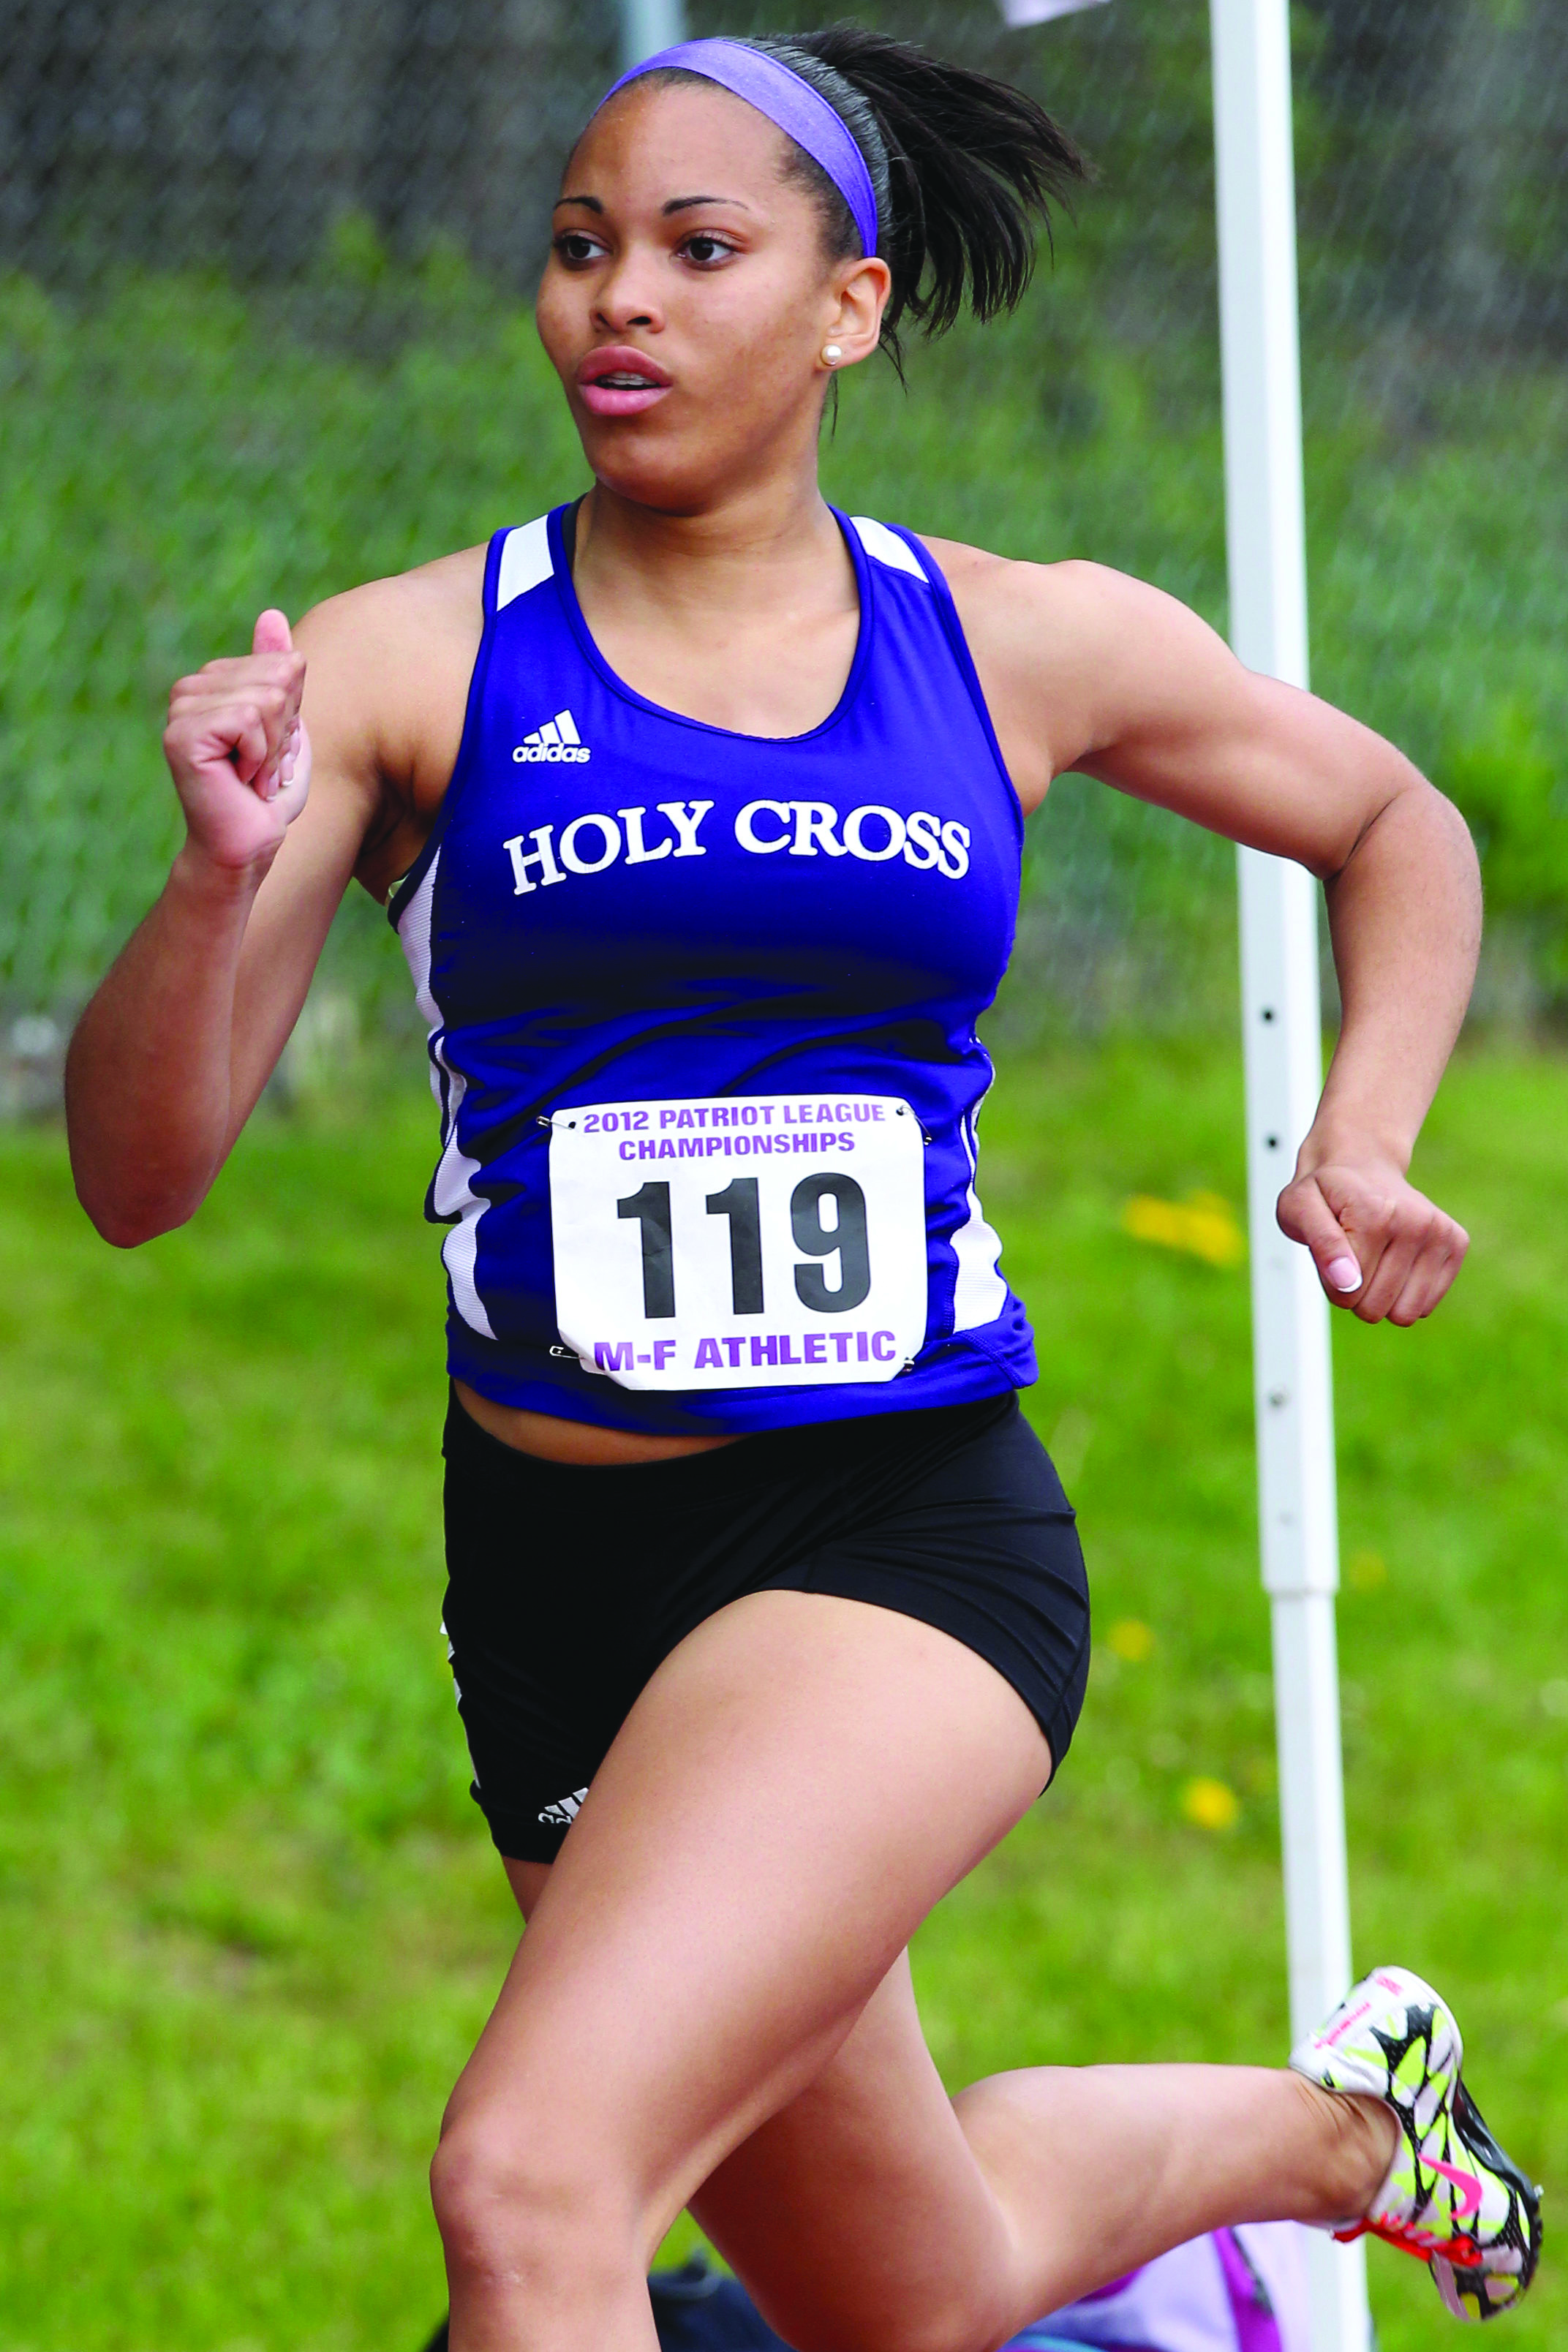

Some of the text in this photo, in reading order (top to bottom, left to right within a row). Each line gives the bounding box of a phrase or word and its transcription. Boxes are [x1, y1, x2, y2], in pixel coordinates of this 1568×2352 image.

[512, 742, 591, 764] adidas
[502, 799, 970, 895] HOLY CROSS
[584, 1103, 886, 1134] 2012 PATRIOT LEAGUE
[618, 1131, 856, 1161] CHAMPIONSHIPS
[616, 1172, 872, 1319] 119
[593, 1330, 897, 1372] M-F ATHLETIC
